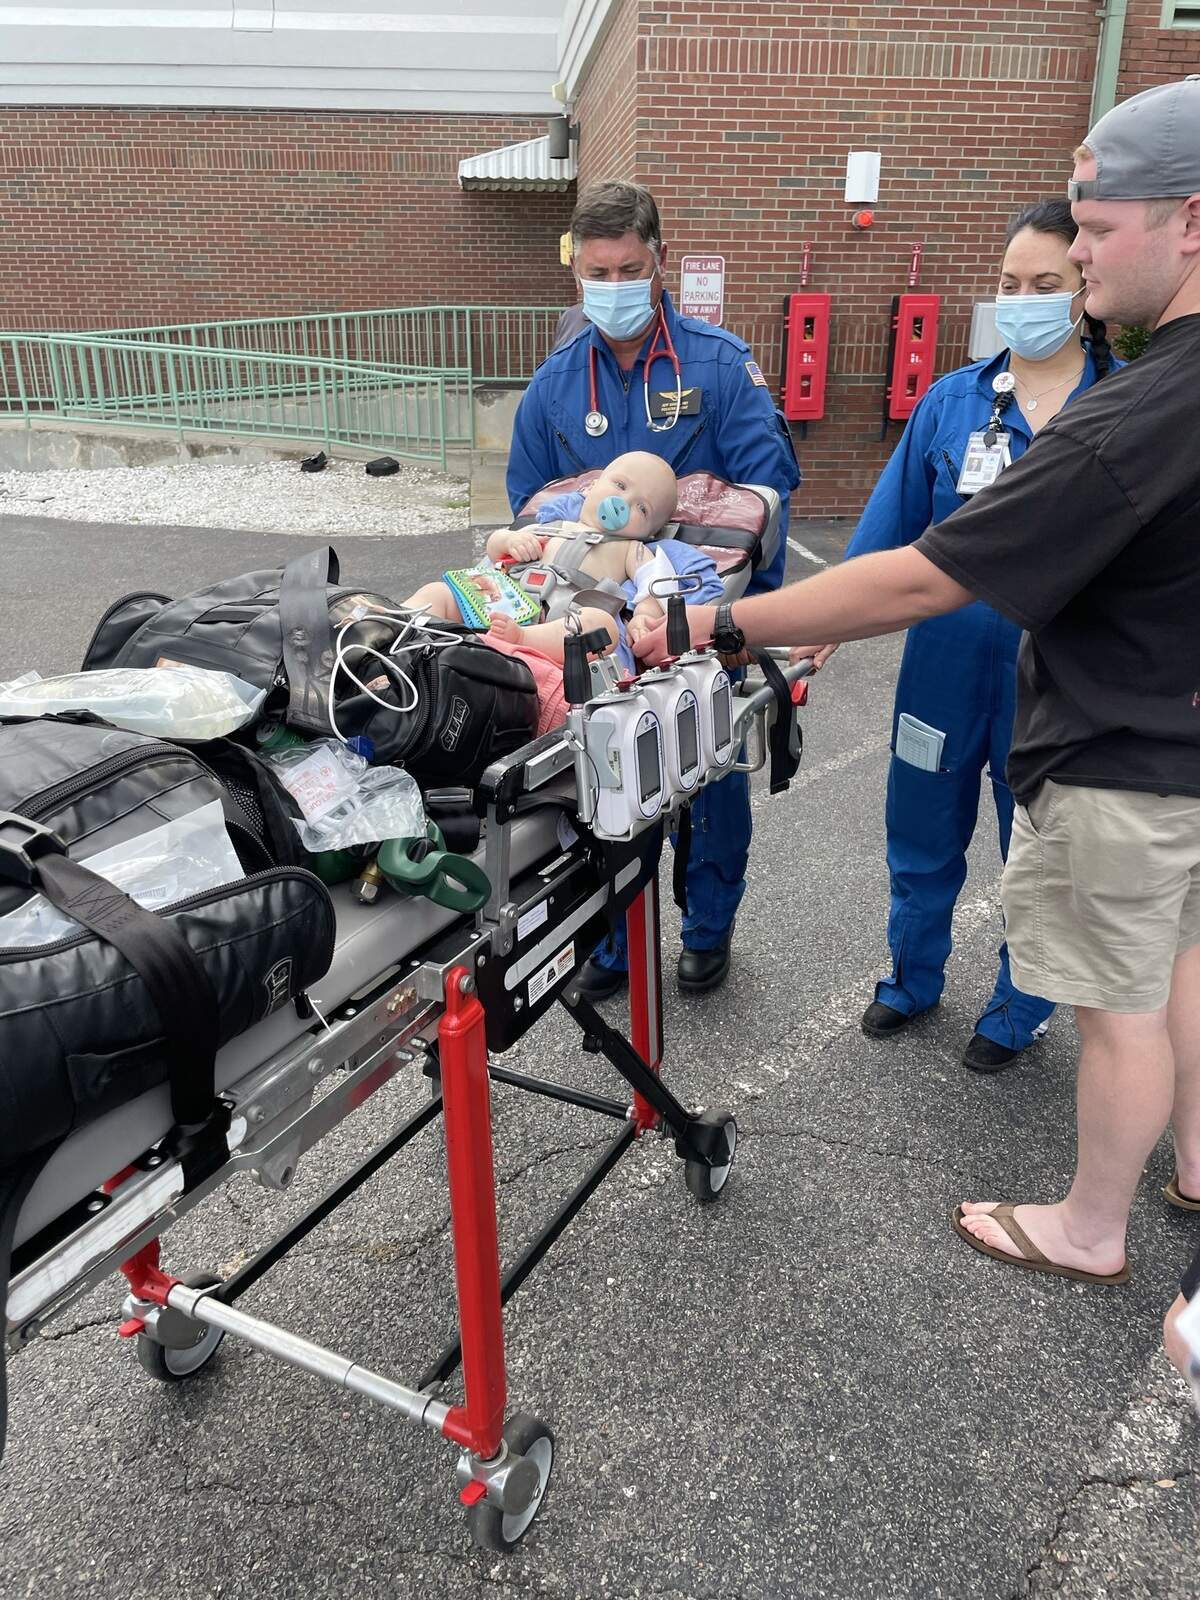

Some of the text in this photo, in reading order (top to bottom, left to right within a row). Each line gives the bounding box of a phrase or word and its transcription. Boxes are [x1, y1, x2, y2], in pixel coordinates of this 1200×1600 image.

[685, 262, 720, 271] FIRE LANE
[696, 276, 708, 286] NO
[684, 291, 719, 301] PARKING
[700, 306, 718, 314] AWAY
